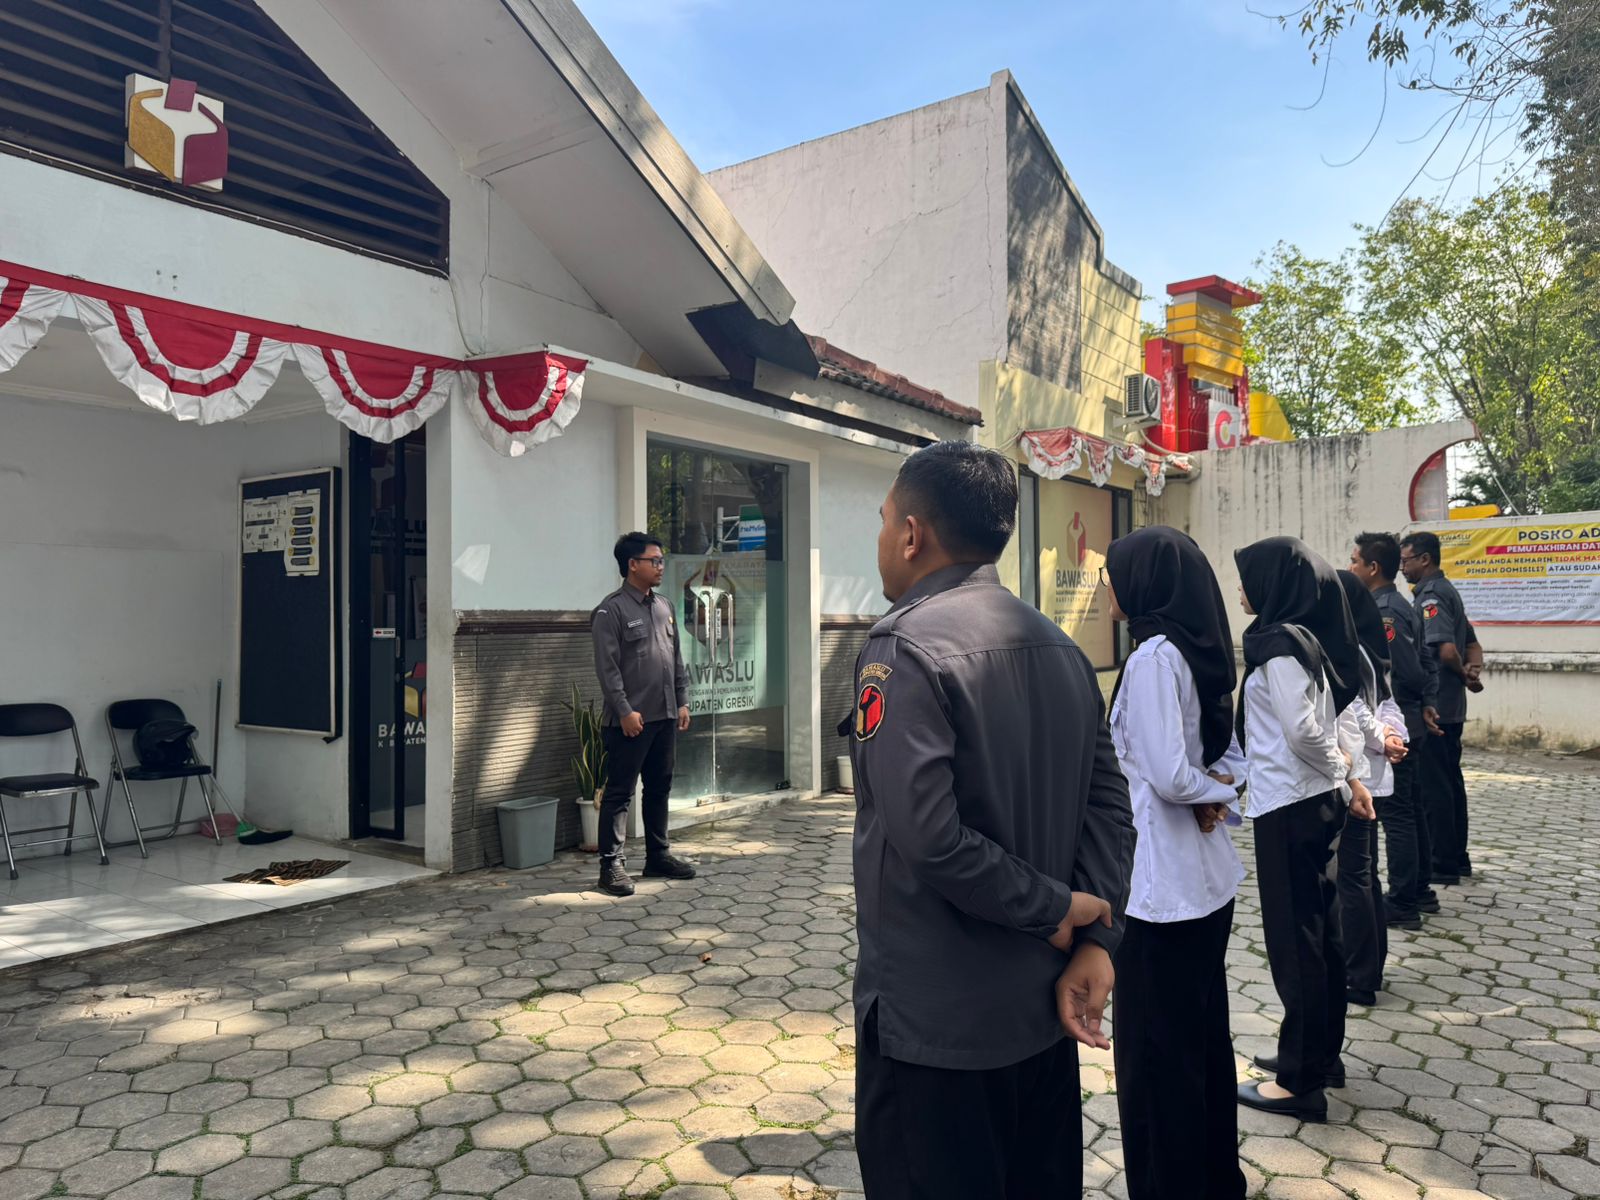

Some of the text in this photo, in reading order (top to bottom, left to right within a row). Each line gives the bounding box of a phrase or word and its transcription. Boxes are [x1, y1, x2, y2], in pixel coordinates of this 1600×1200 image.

[1519, 529, 1573, 541] POSKO
[1507, 543, 1580, 553] PEMUTAKHIRAN
[1056, 569, 1096, 588] BAWASLU
[686, 660, 754, 684] AWASLU
[689, 696, 754, 712] UPATEN GRESIK
